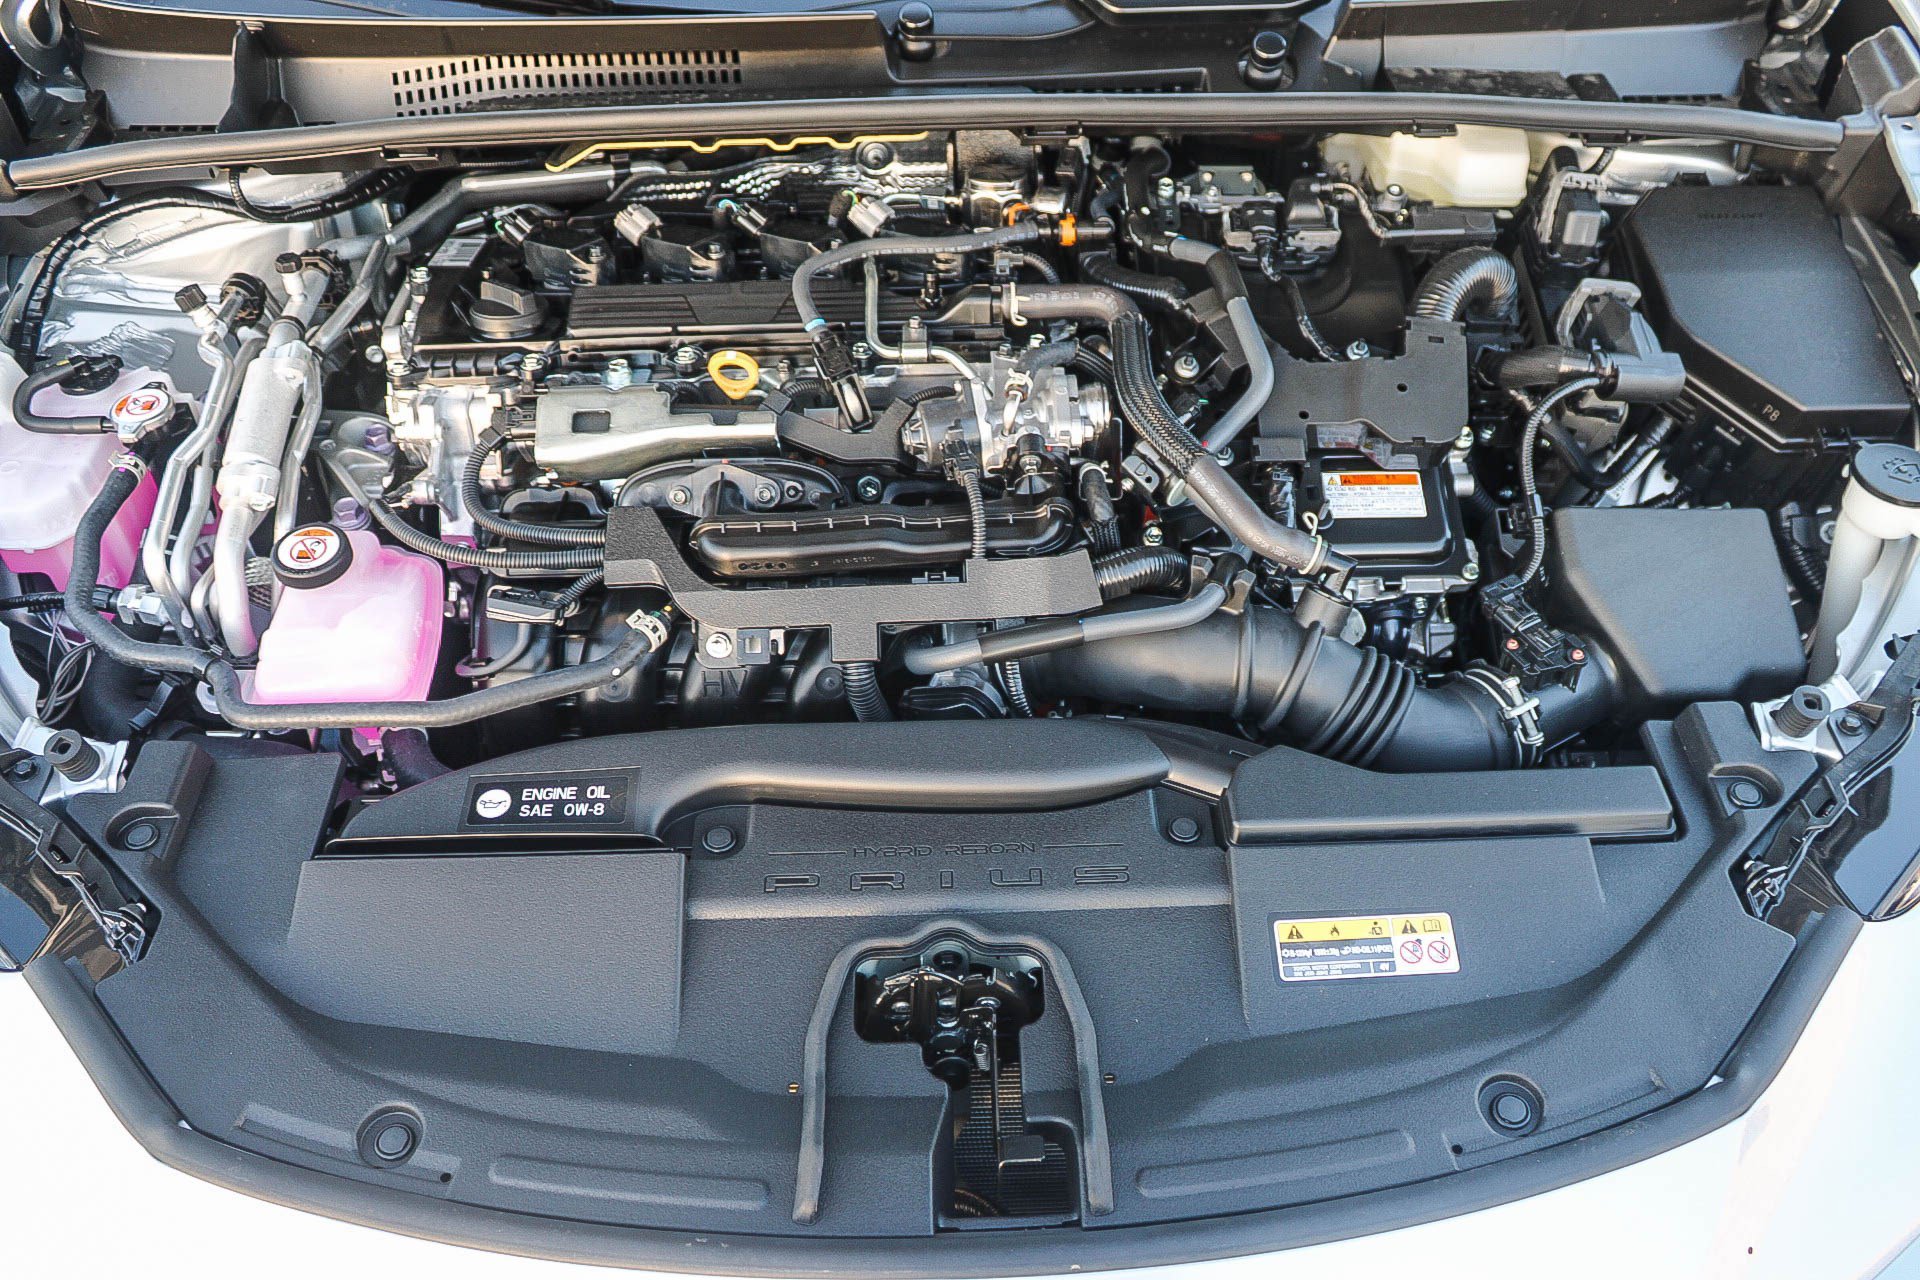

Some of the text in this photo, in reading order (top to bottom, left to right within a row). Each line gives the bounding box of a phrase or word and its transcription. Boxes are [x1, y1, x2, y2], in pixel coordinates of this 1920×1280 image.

[521, 785, 611, 801] ENGINE OIL
[519, 804, 554, 817] SAE
[853, 842, 1036, 857] HYBRID REBORN
[763, 865, 1130, 893] PRIUS
